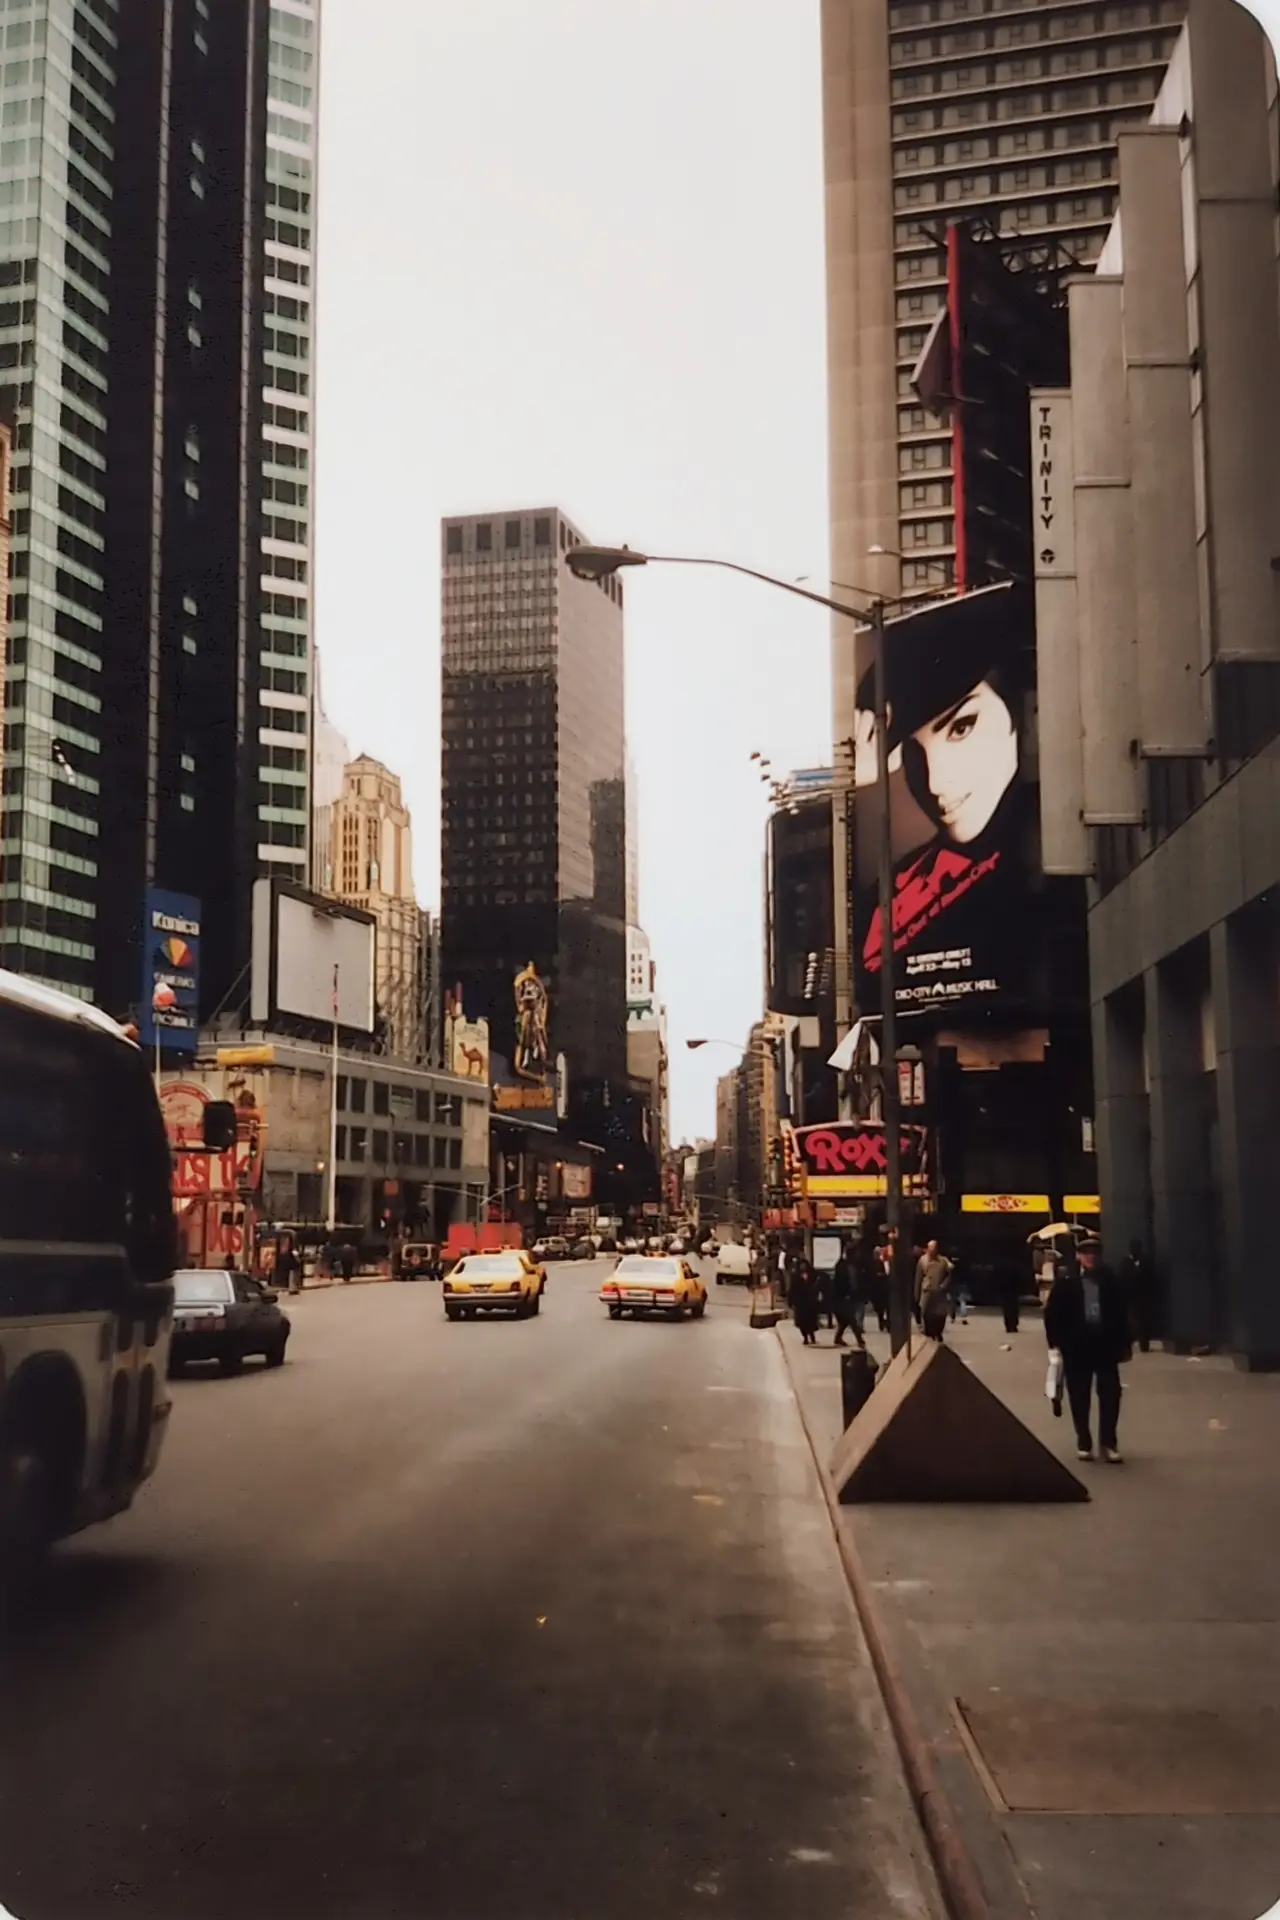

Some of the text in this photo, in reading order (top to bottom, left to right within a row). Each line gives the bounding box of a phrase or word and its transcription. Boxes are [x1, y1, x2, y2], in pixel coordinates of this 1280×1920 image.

[1038, 406, 1054, 530] TRINITY
[152, 910, 200, 936] Konica
[895, 986, 932, 1000] DIO-CITY
[974, 978, 998, 992] HALL
